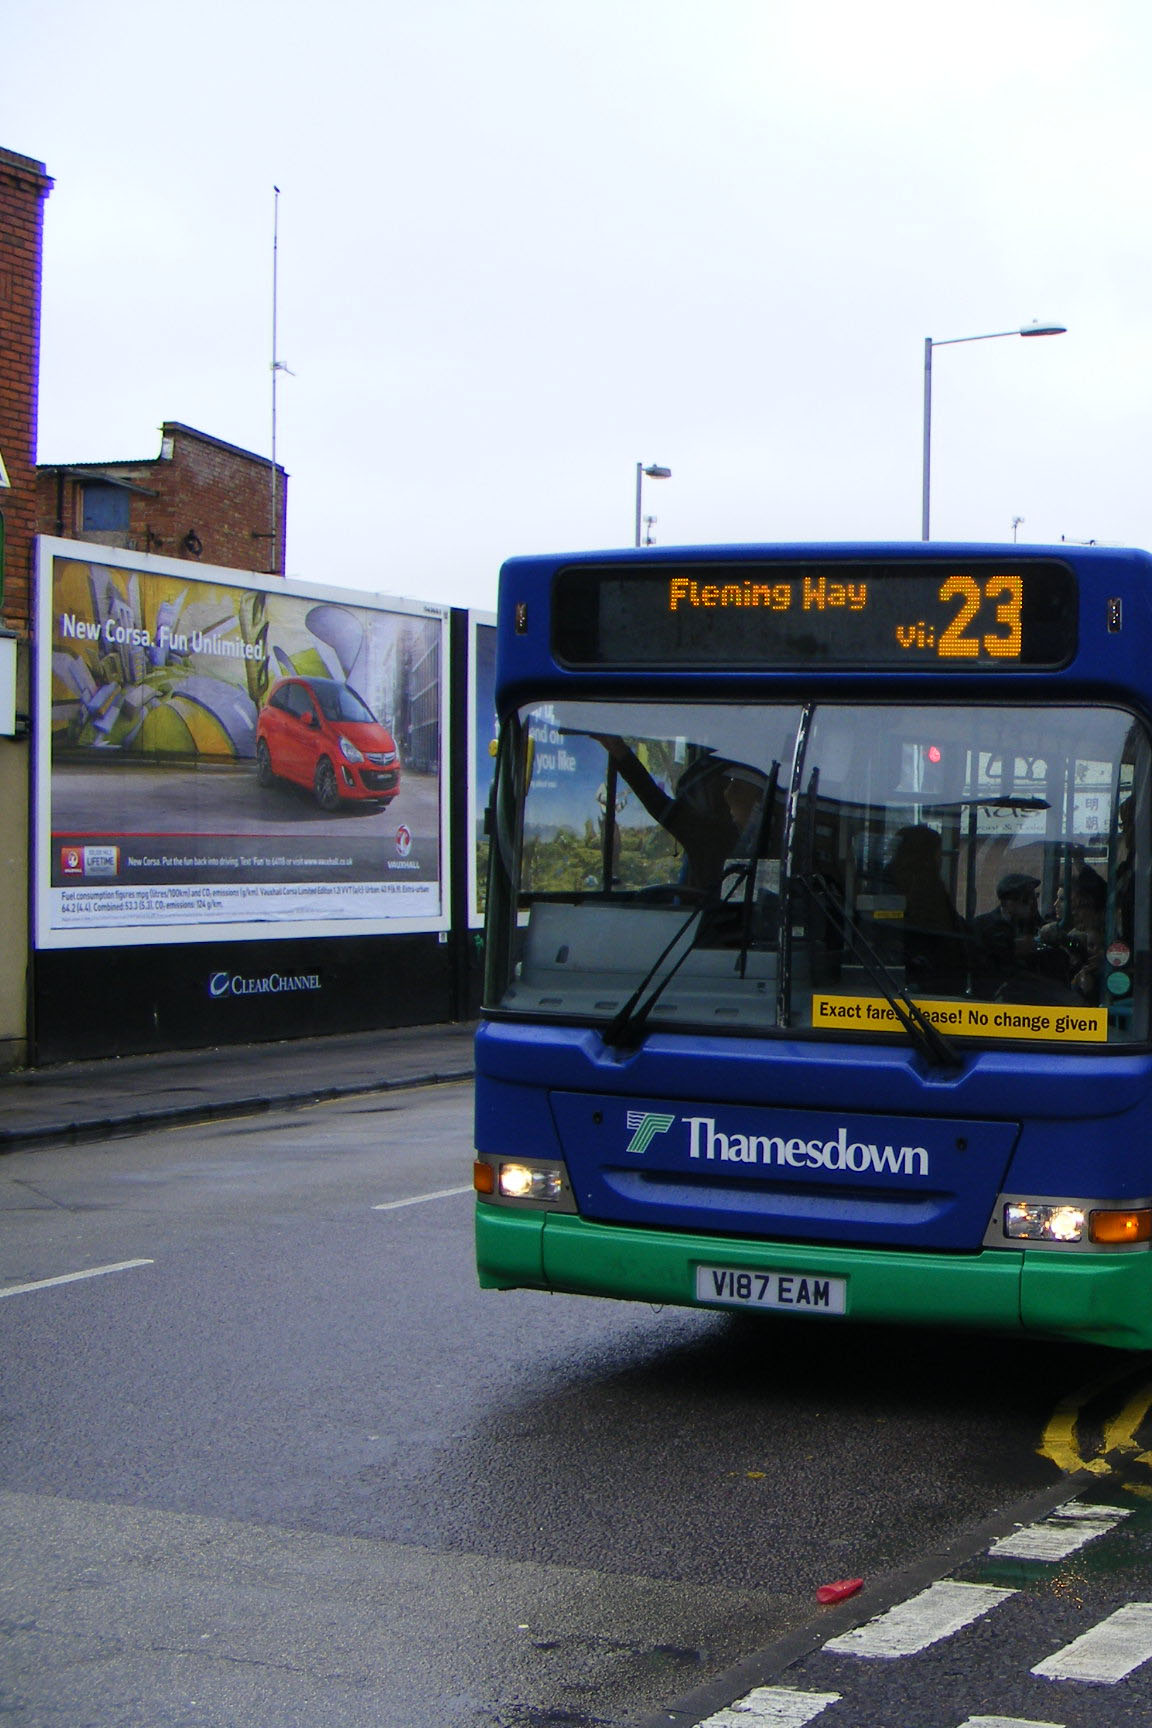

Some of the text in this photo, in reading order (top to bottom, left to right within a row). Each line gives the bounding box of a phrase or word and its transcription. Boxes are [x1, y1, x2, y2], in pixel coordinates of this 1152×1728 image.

[670, 577, 867, 610] Fleming Way
[938, 576, 1023, 656] 23
[63, 613, 266, 660] New Corsa. Fun Unlimited.
[558, 751, 576, 771] like
[819, 1001, 861, 1019] Exact
[969, 1010, 989, 1026] No
[994, 1012, 1050, 1032] change
[1055, 1015, 1098, 1033] given
[681, 1117, 929, 1176] Thamesdown
[712, 1271, 830, 1307] V187 EAM
